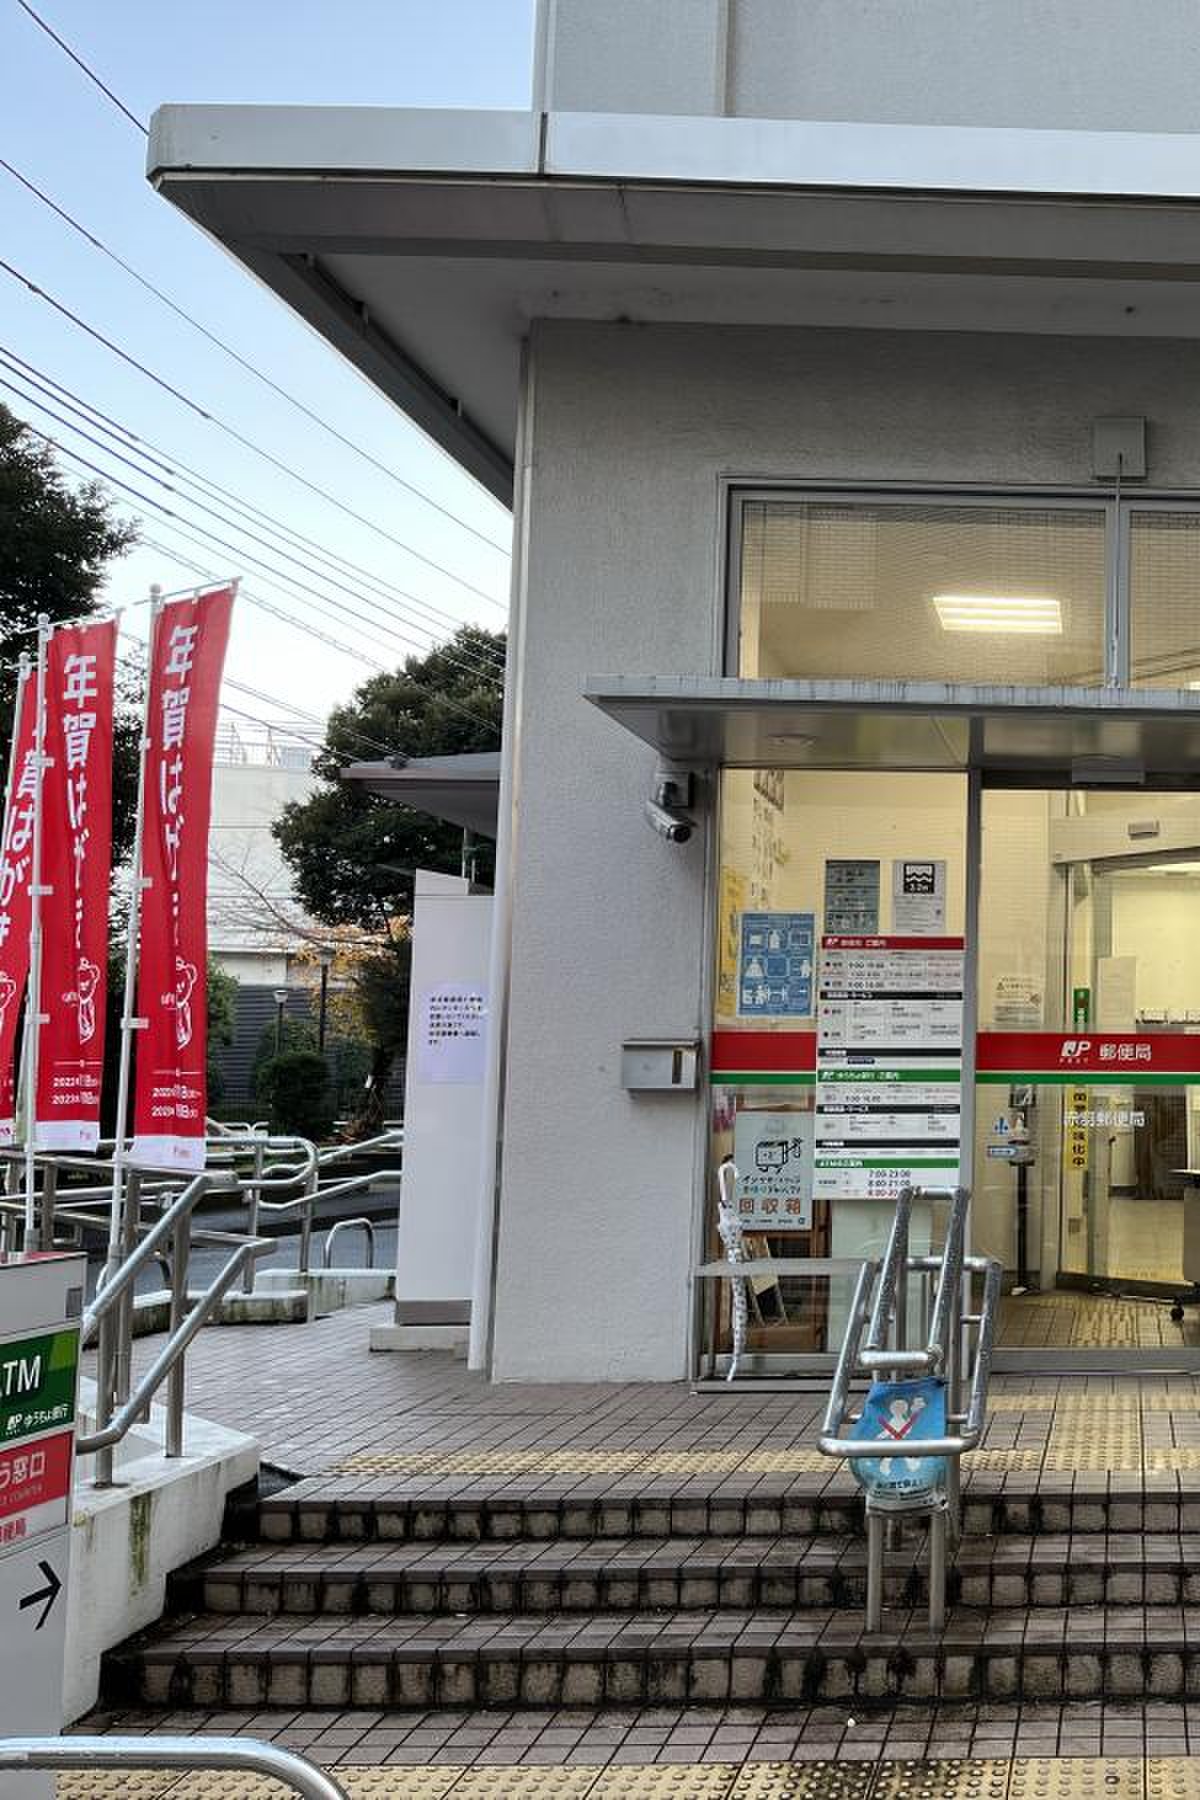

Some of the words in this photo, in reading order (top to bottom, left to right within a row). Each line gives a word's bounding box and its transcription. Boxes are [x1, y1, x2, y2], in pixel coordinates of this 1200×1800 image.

[1099, 1043, 1152, 1061] 郵便局
[0, 1354, 42, 1399] TM
